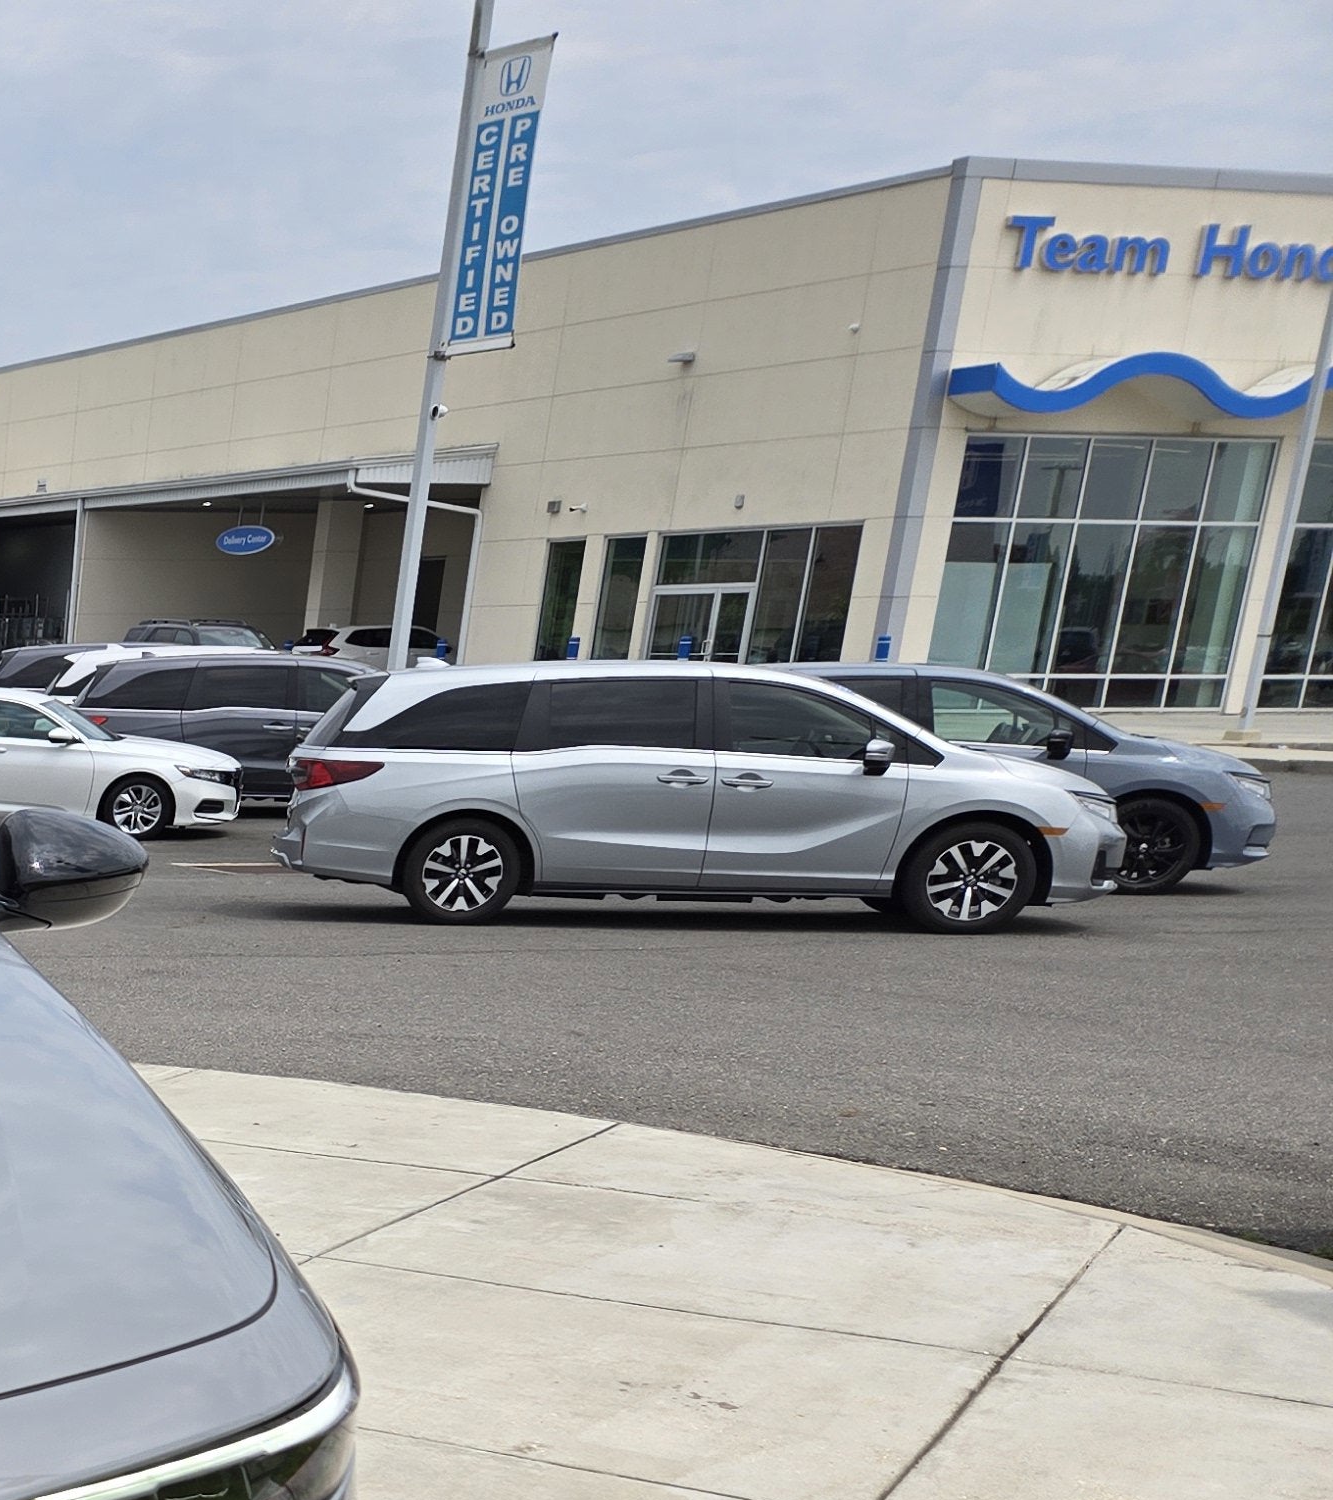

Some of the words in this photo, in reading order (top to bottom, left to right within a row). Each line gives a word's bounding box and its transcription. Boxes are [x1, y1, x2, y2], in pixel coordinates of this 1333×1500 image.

[484, 96, 536, 117] HONDA
[507, 118, 532, 188] PRE
[455, 126, 499, 336] CERTIFIED
[1007, 215, 1170, 276] Team
[491, 215, 519, 333] OWNED
[223, 536, 246, 546] Delivery
[247, 534, 267, 543] Center
